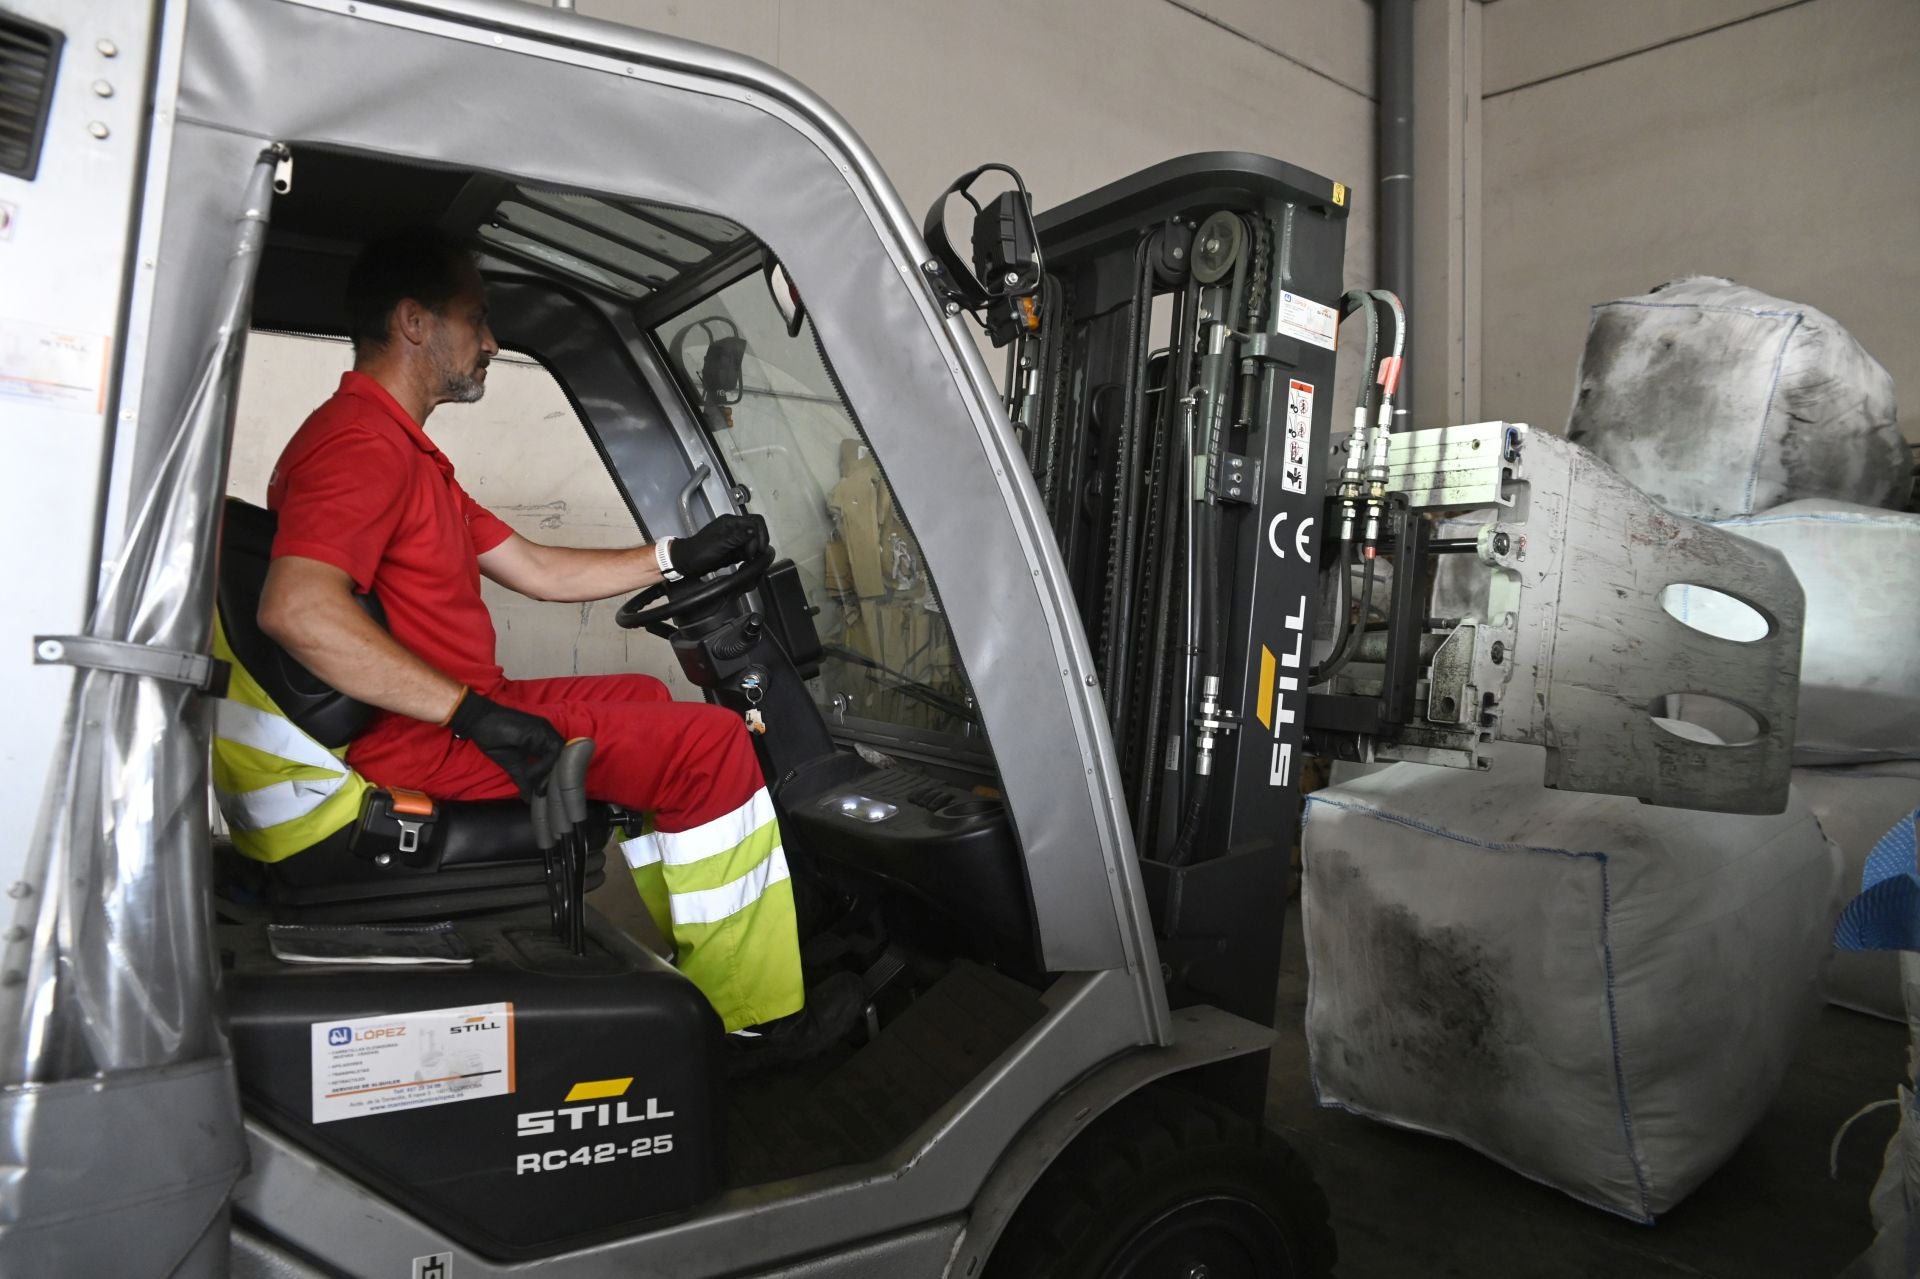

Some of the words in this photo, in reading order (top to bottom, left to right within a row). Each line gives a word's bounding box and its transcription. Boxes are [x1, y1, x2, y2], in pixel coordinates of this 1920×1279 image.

[1268, 511, 1315, 564] CE
[1269, 595, 1307, 787] STILL
[450, 1022, 501, 1035] STILL
[517, 1097, 675, 1137] STILL
[516, 1133, 674, 1176] RC42-25
